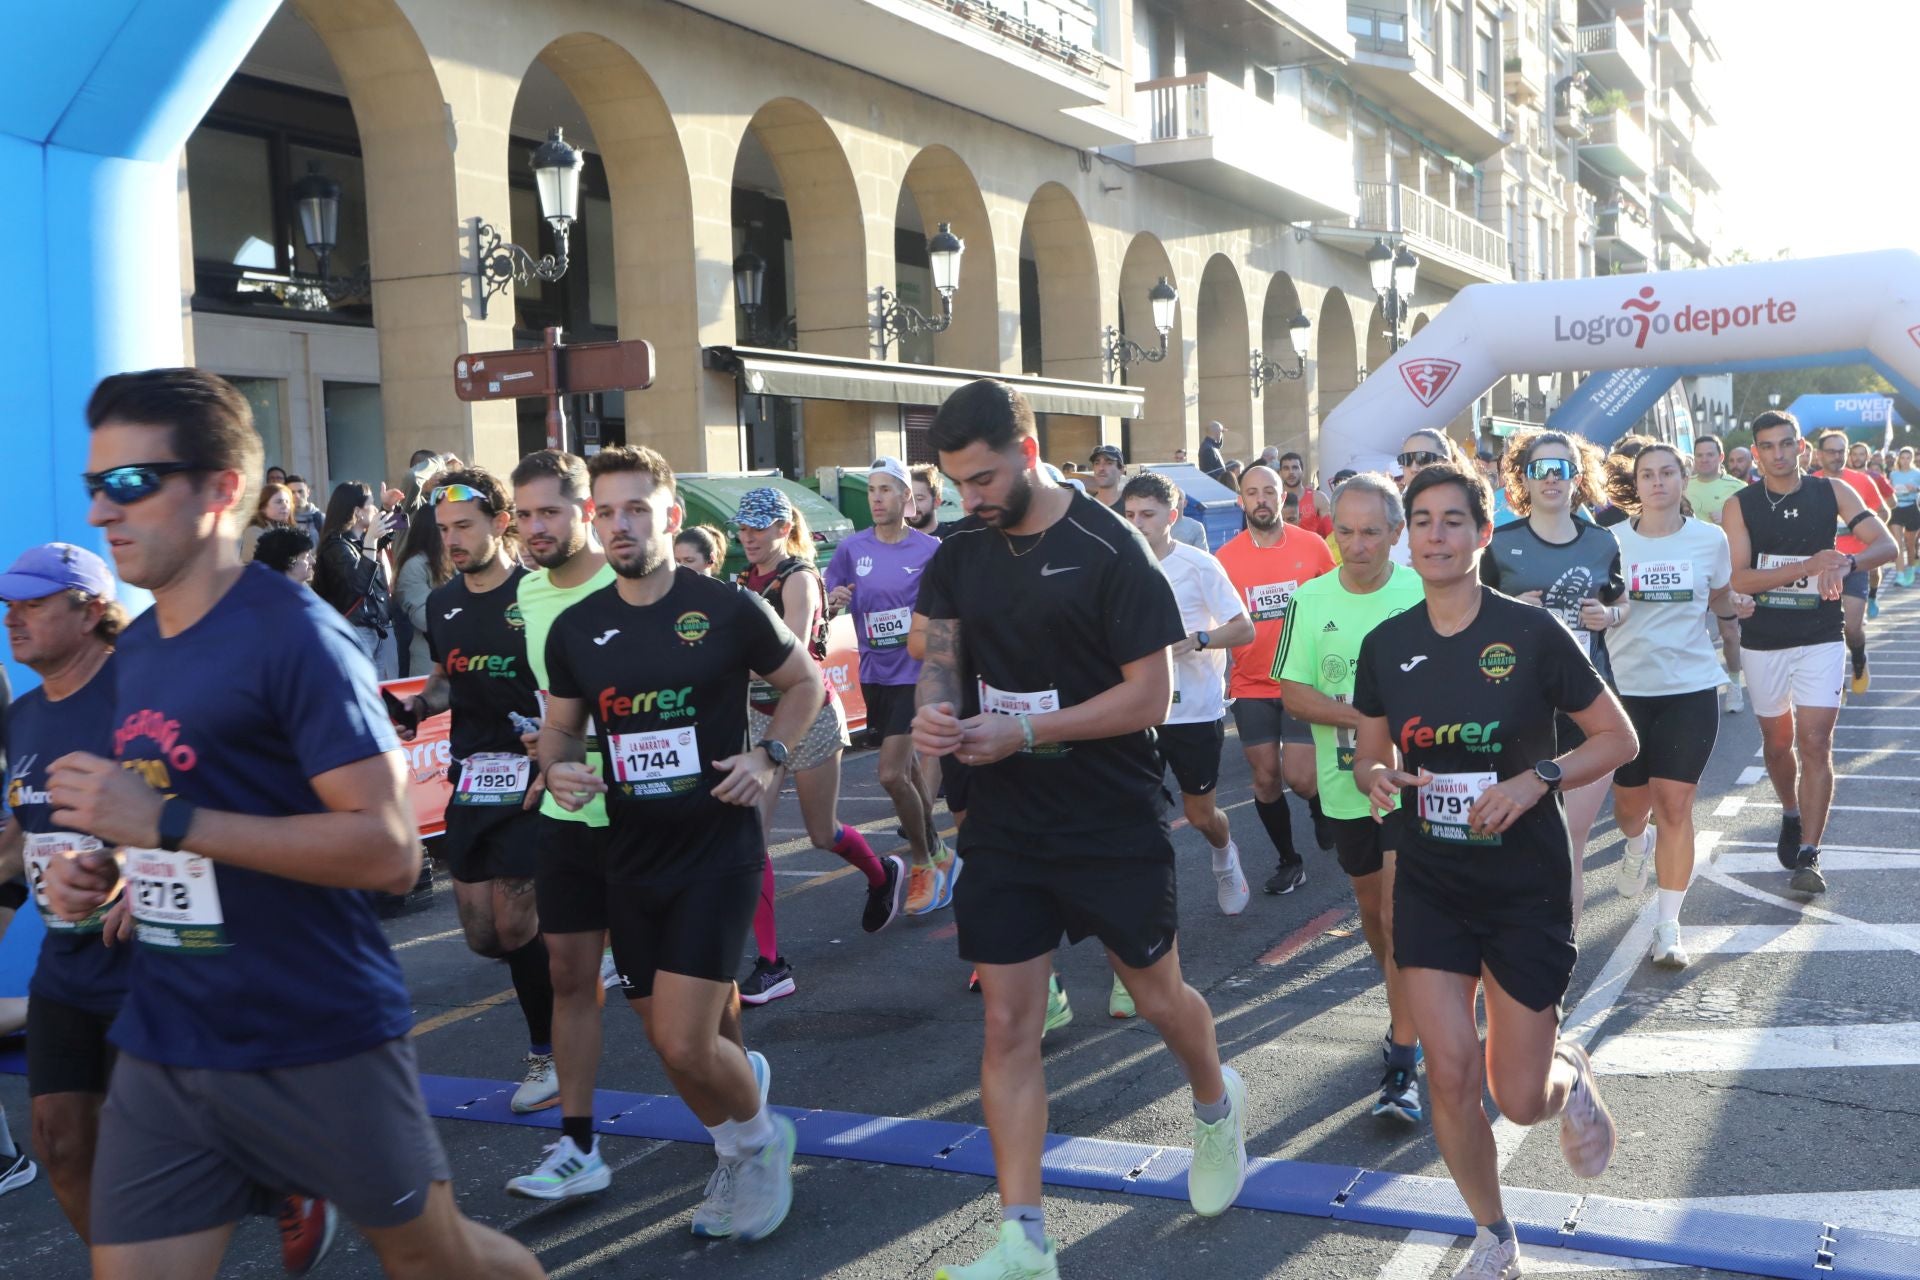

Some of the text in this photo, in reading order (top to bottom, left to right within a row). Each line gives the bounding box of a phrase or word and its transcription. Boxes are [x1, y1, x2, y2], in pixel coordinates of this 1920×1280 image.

[1673, 297, 1797, 336] deporte
[1589, 367, 1629, 404] Tu salu
[1600, 367, 1641, 410] nuestra
[1606, 374, 1650, 417] vocación.
[1834, 398, 1894, 412] POWER
[1641, 573, 1681, 585] 1255
[1257, 593, 1289, 606] 1536
[873, 620, 903, 633] 1604
[660, 708, 685, 720] sport
[1466, 744, 1491, 753] sport
[627, 750, 680, 772] 1744
[474, 774, 516, 788] 1920
[1435, 782, 1468, 794] MARATÓN
[1426, 794, 1475, 814] 1791
